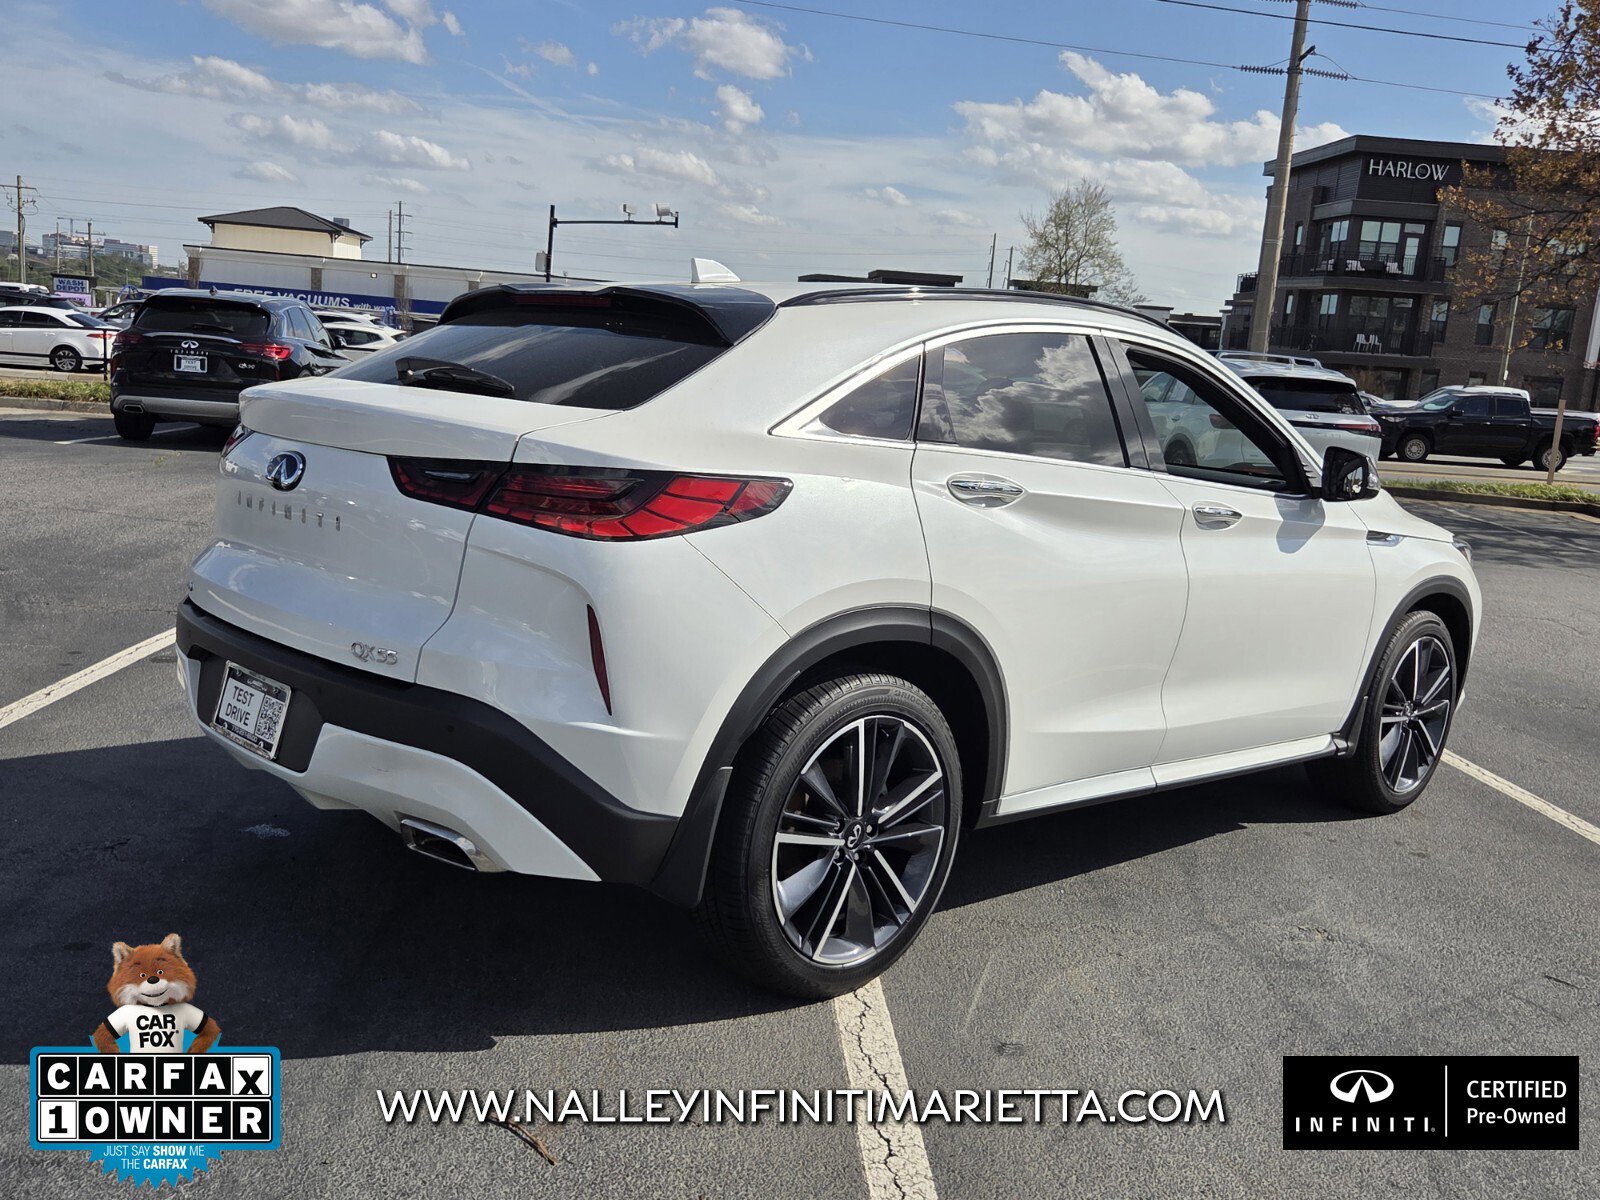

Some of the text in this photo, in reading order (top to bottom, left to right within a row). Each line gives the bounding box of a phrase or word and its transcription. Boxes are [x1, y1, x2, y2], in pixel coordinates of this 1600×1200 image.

[1368, 158, 1450, 181] HARLOW
[237, 490, 341, 532] INFINITI
[233, 685, 254, 707] TEST
[225, 702, 251, 726] DRIVE
[894, 690, 944, 730] BRIDGESTO
